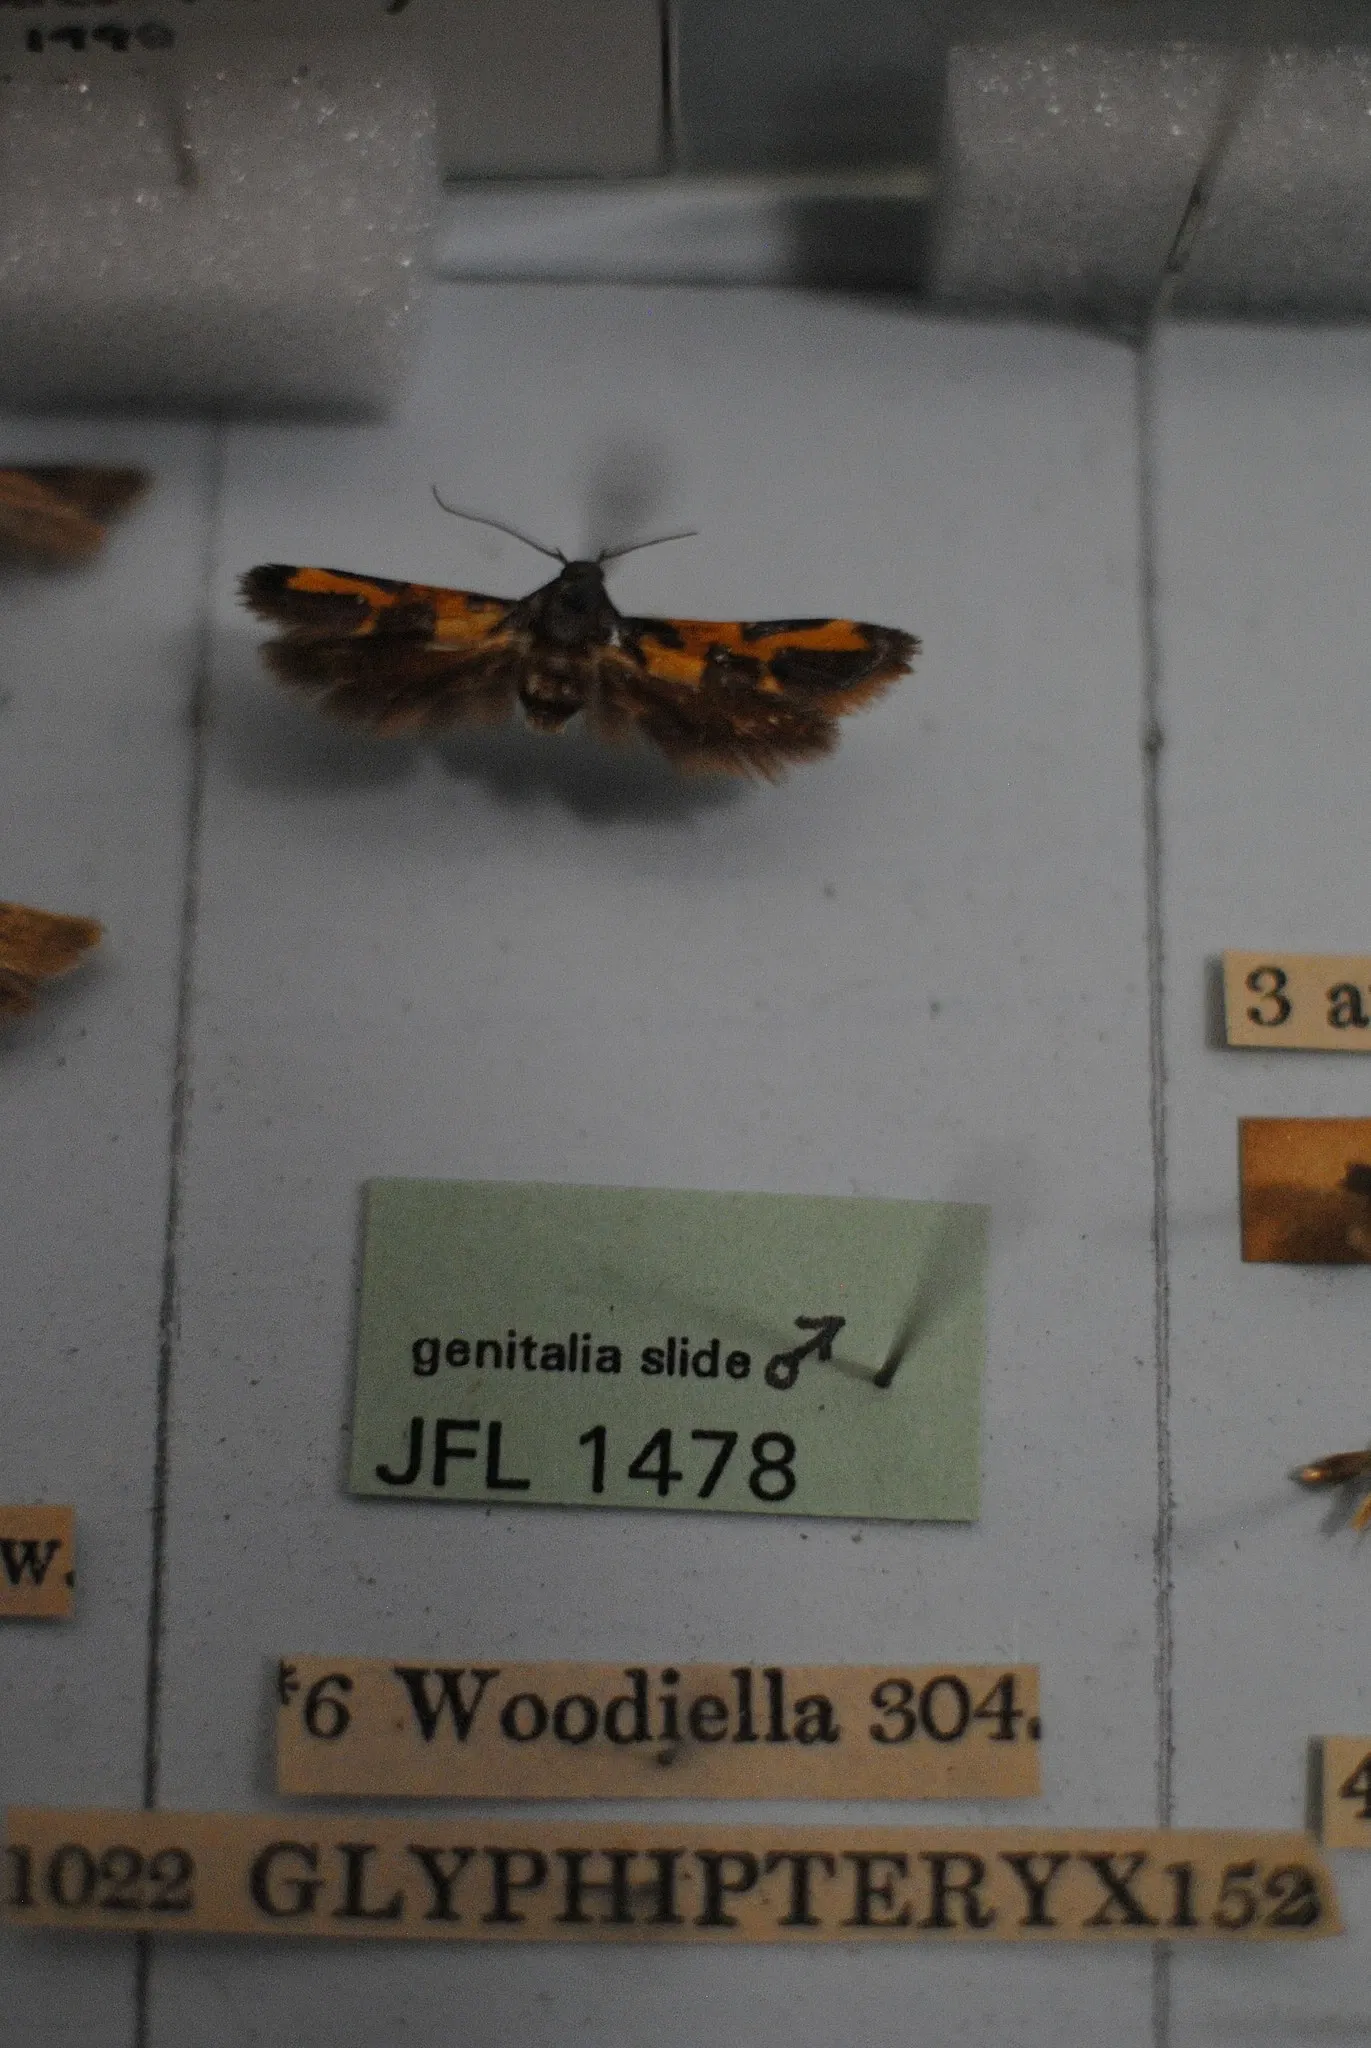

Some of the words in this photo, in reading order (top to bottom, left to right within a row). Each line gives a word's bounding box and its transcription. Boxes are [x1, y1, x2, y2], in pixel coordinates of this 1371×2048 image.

[1245, 965, 1291, 1026] 3
[412, 1330, 622, 1376] genitalia
[641, 1338, 752, 1380] slide
[375, 1416, 531, 1490] JFL
[579, 1425, 797, 1501] 1478
[395, 1667, 841, 1744] Woodiella
[4, 1843, 194, 1912] 1022
